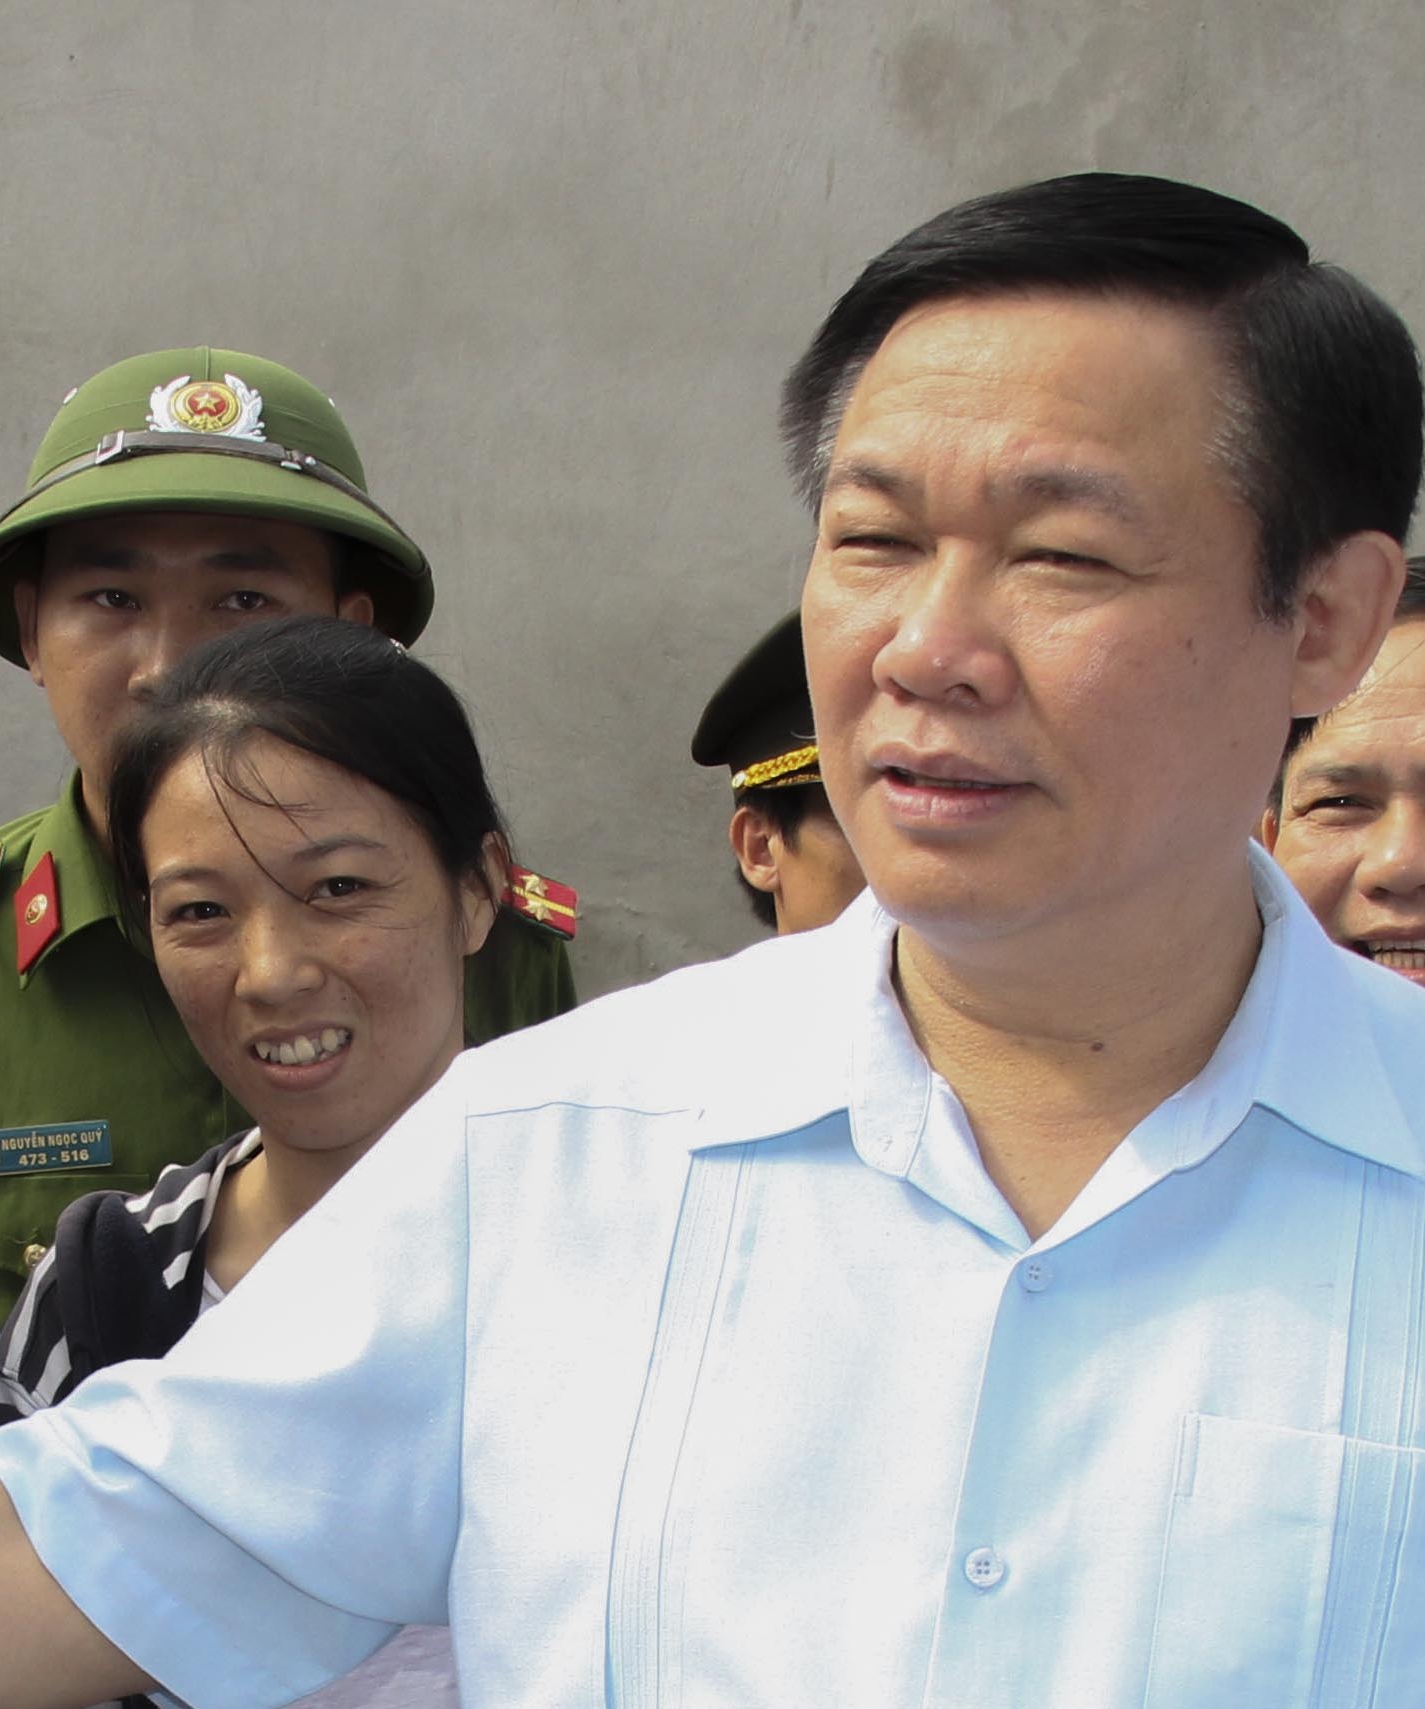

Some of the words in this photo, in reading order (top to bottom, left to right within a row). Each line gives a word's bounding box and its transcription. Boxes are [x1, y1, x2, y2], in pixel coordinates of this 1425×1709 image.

[1, 1131, 46, 1150] NGUYỄN
[48, 1133, 78, 1148] NGỌC
[18, 1153, 47, 1166] 473
[60, 1149, 90, 1163] 516
